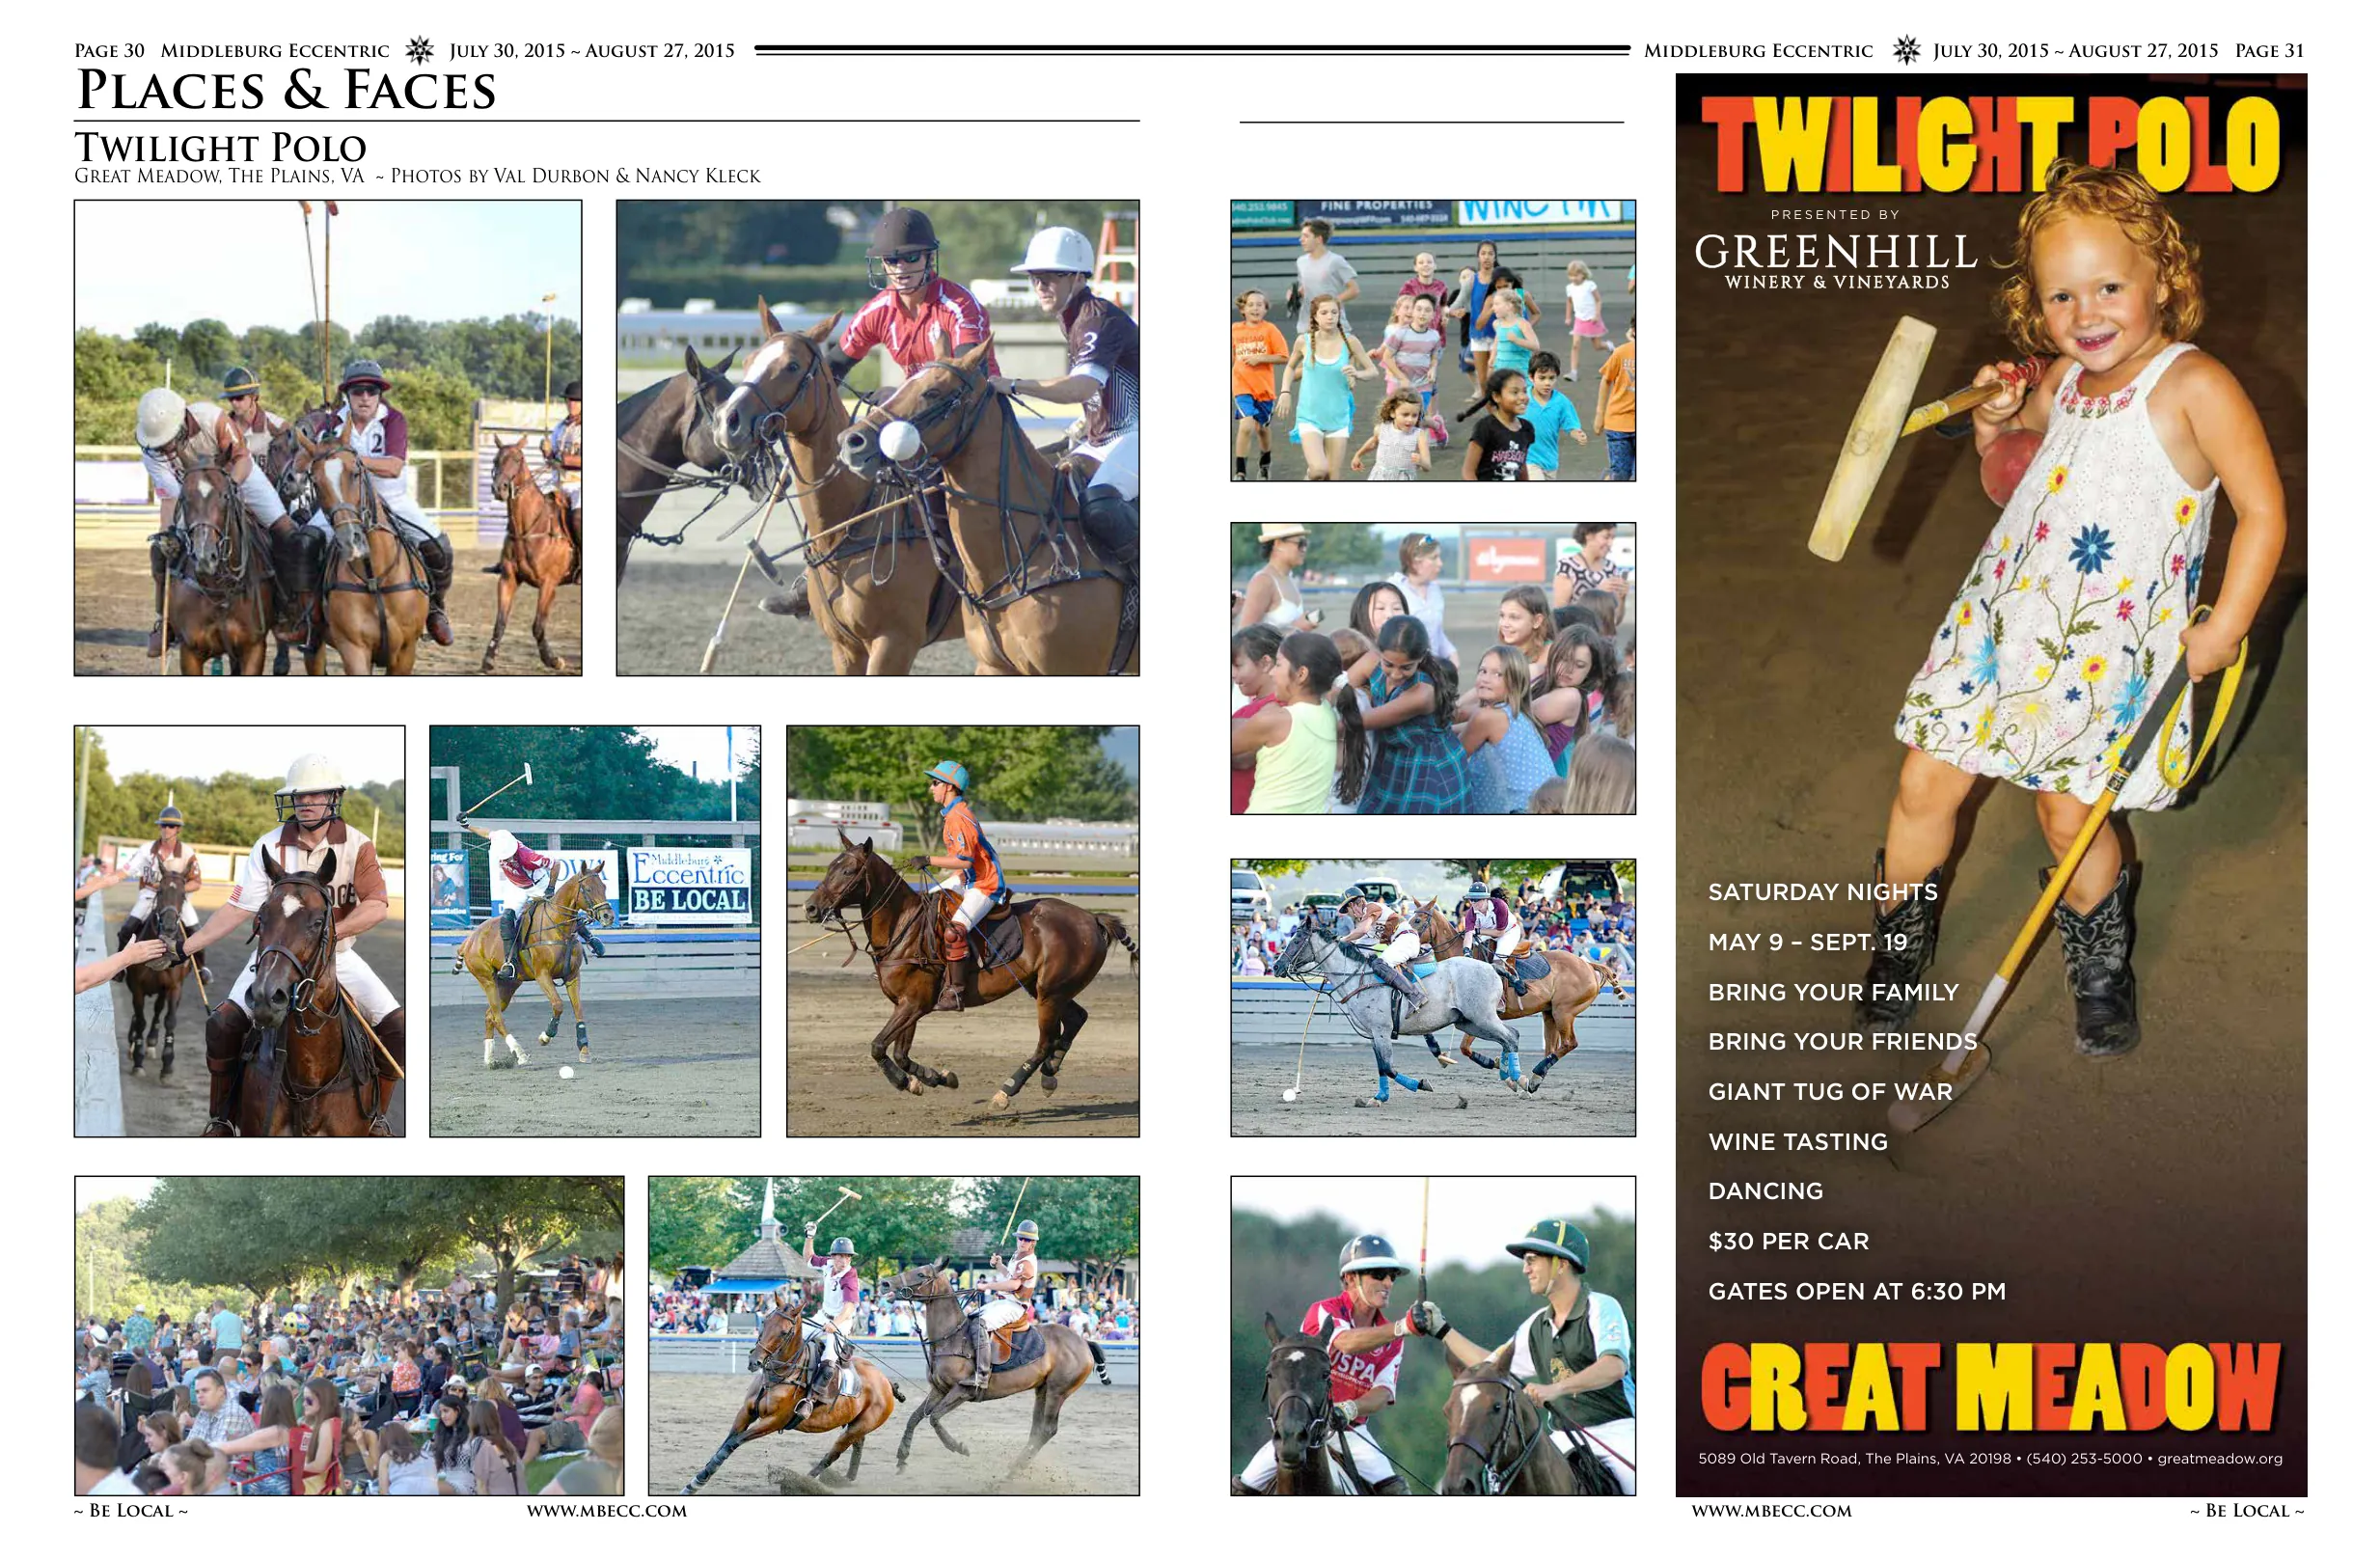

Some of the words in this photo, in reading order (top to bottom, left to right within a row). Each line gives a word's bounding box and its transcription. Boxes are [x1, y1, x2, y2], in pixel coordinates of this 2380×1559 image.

[76, 42, 119, 58] PAGE
[124, 42, 145, 58] 30
[160, 42, 282, 58] MIDDLEBURG
[290, 42, 390, 58] ECCENTRIC
[450, 42, 489, 61] JULY
[495, 42, 518, 61] 30,
[525, 42, 565, 58] 2015
[585, 42, 659, 58] AUGUST
[664, 42, 688, 61] 27,
[695, 42, 735, 58] 2015
[1644, 42, 1765, 58] MIDDLEBURG
[1773, 42, 1874, 58] ECCENTRIC
[1933, 42, 1973, 61] JULY
[1978, 42, 2002, 61] 30,
[2009, 42, 2049, 58] 2015
[2068, 42, 2143, 58] AUGUST
[2147, 42, 2172, 61] 27,
[2178, 42, 2219, 58] 2015
[2236, 42, 2280, 58] PAGE
[2285, 42, 2303, 58] 31
[77, 68, 264, 110] PLACES
[284, 68, 330, 110] &
[343, 68, 496, 110] FACES
[75, 131, 260, 163] TWILIGHT
[272, 131, 367, 163] POLO
[1702, 96, 2074, 193] TWILIGHT
[2088, 96, 2281, 193] POLO
[75, 168, 131, 183] GREAT
[137, 168, 222, 186] MEADOW,
[228, 168, 263, 183] THE
[271, 168, 335, 186] PLAINS,
[340, 168, 365, 183] VA
[392, 168, 462, 183] PHOTOS
[469, 168, 489, 183] BY
[493, 168, 526, 183] VAL
[533, 168, 610, 183] DURBON
[616, 168, 631, 183] &
[637, 168, 699, 183] NANCY
[706, 168, 761, 183] KLECK
[1321, 201, 1352, 211] FINE
[1356, 201, 1434, 210] PROPERTIES
[1771, 209, 1871, 220] PRESENTED
[1879, 209, 1900, 220] BY
[1695, 233, 1978, 269] GREENHILL
[1724, 274, 1806, 289] WINERY
[1813, 274, 1827, 289] &
[1832, 274, 1950, 289] VINEYARDS
[1079, 331, 1098, 356] 3
[370, 433, 383, 453] 2
[449, 852, 464, 862] For
[632, 852, 746, 885] Eccentric
[634, 889, 666, 911] BE
[671, 889, 746, 911] LOCAL
[1709, 883, 1840, 901] SATURDAY
[1847, 883, 1938, 901] NIGHTS
[1710, 933, 1762, 951] MAY
[1769, 933, 1783, 951] 9
[1810, 933, 1875, 951] SEPT.
[1884, 933, 1907, 951] 19
[1710, 983, 1786, 1001] BRING
[1793, 983, 1864, 1001] YOUR
[1873, 983, 1959, 1001] FAMILY
[1710, 1032, 1786, 1051] BRING
[1793, 1032, 1864, 1051] YOUR
[1873, 1032, 1978, 1051] FRIENDS
[1709, 1082, 1786, 1101] GIANT
[1793, 1082, 1844, 1101] TUG
[1851, 1082, 1886, 1101] OF
[1894, 1082, 1953, 1101] WAR
[1709, 1133, 1775, 1151] WINE
[1783, 1133, 1888, 1151] TASTING
[1710, 1182, 1823, 1200] DANCING
[1709, 1231, 1754, 1251] $30
[1763, 1231, 1810, 1251] PER
[1818, 1231, 1870, 1251] CAR
[1709, 1282, 1788, 1300] GATES
[1796, 1282, 1864, 1300] OPEN
[1873, 1282, 1903, 1300] AT
[1911, 1282, 1963, 1300] 6:30
[1972, 1282, 2006, 1300] PM
[1701, 1342, 1941, 1432] GREAT
[1956, 1342, 2282, 1432] MEADOW
[1698, 1452, 1737, 1464] 5089
[1739, 1452, 1765, 1464] Old
[1769, 1452, 1817, 1464] Tavern
[1821, 1452, 1861, 1466] Road,
[1865, 1452, 1892, 1464] The
[1897, 1452, 1940, 1466] Plains,
[1944, 1452, 1965, 1464] VA
[1969, 1452, 2011, 1464] 20198
[2026, 1452, 2066, 1466] (540)
[2070, 1452, 2143, 1464] 253-5000
[2157, 1452, 2283, 1467] greatmeadow.org
[90, 1502, 111, 1518] BE
[117, 1502, 174, 1518] LOCAL
[527, 1503, 688, 1518] WWW.MBECC.COM
[1691, 1503, 1852, 1518] WWW.MBECC.COM
[2206, 1502, 2227, 1518] BE
[2233, 1502, 2290, 1518] LOCAL
